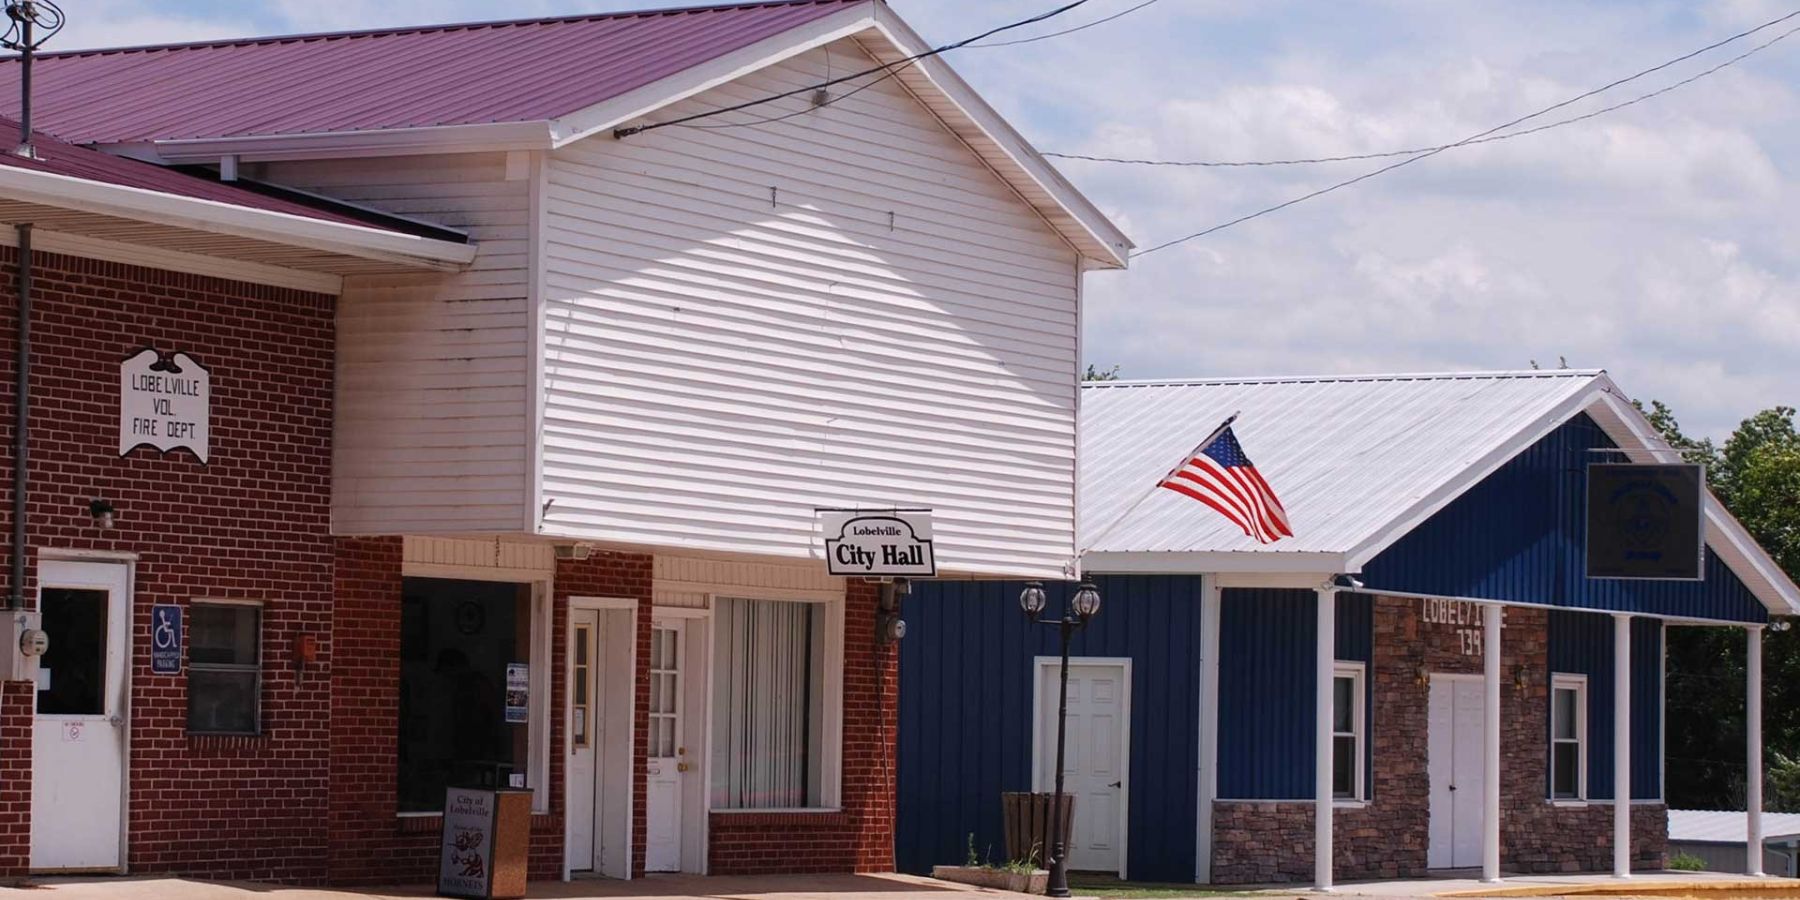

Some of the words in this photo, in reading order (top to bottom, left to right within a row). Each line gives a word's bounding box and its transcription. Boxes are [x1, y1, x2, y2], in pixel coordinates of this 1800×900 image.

[132, 374, 200, 396] LOBELVILLE
[153, 398, 177, 416] VOL.
[133, 418, 158, 436] FIRE
[167, 422, 196, 440] DEPT.
[853, 526, 902, 536] Lobelville
[836, 543, 876, 571] City
[881, 544, 925, 566] Hall
[456, 795, 473, 805] City
[475, 797, 484, 806] of
[449, 804, 489, 817] Lobelville
